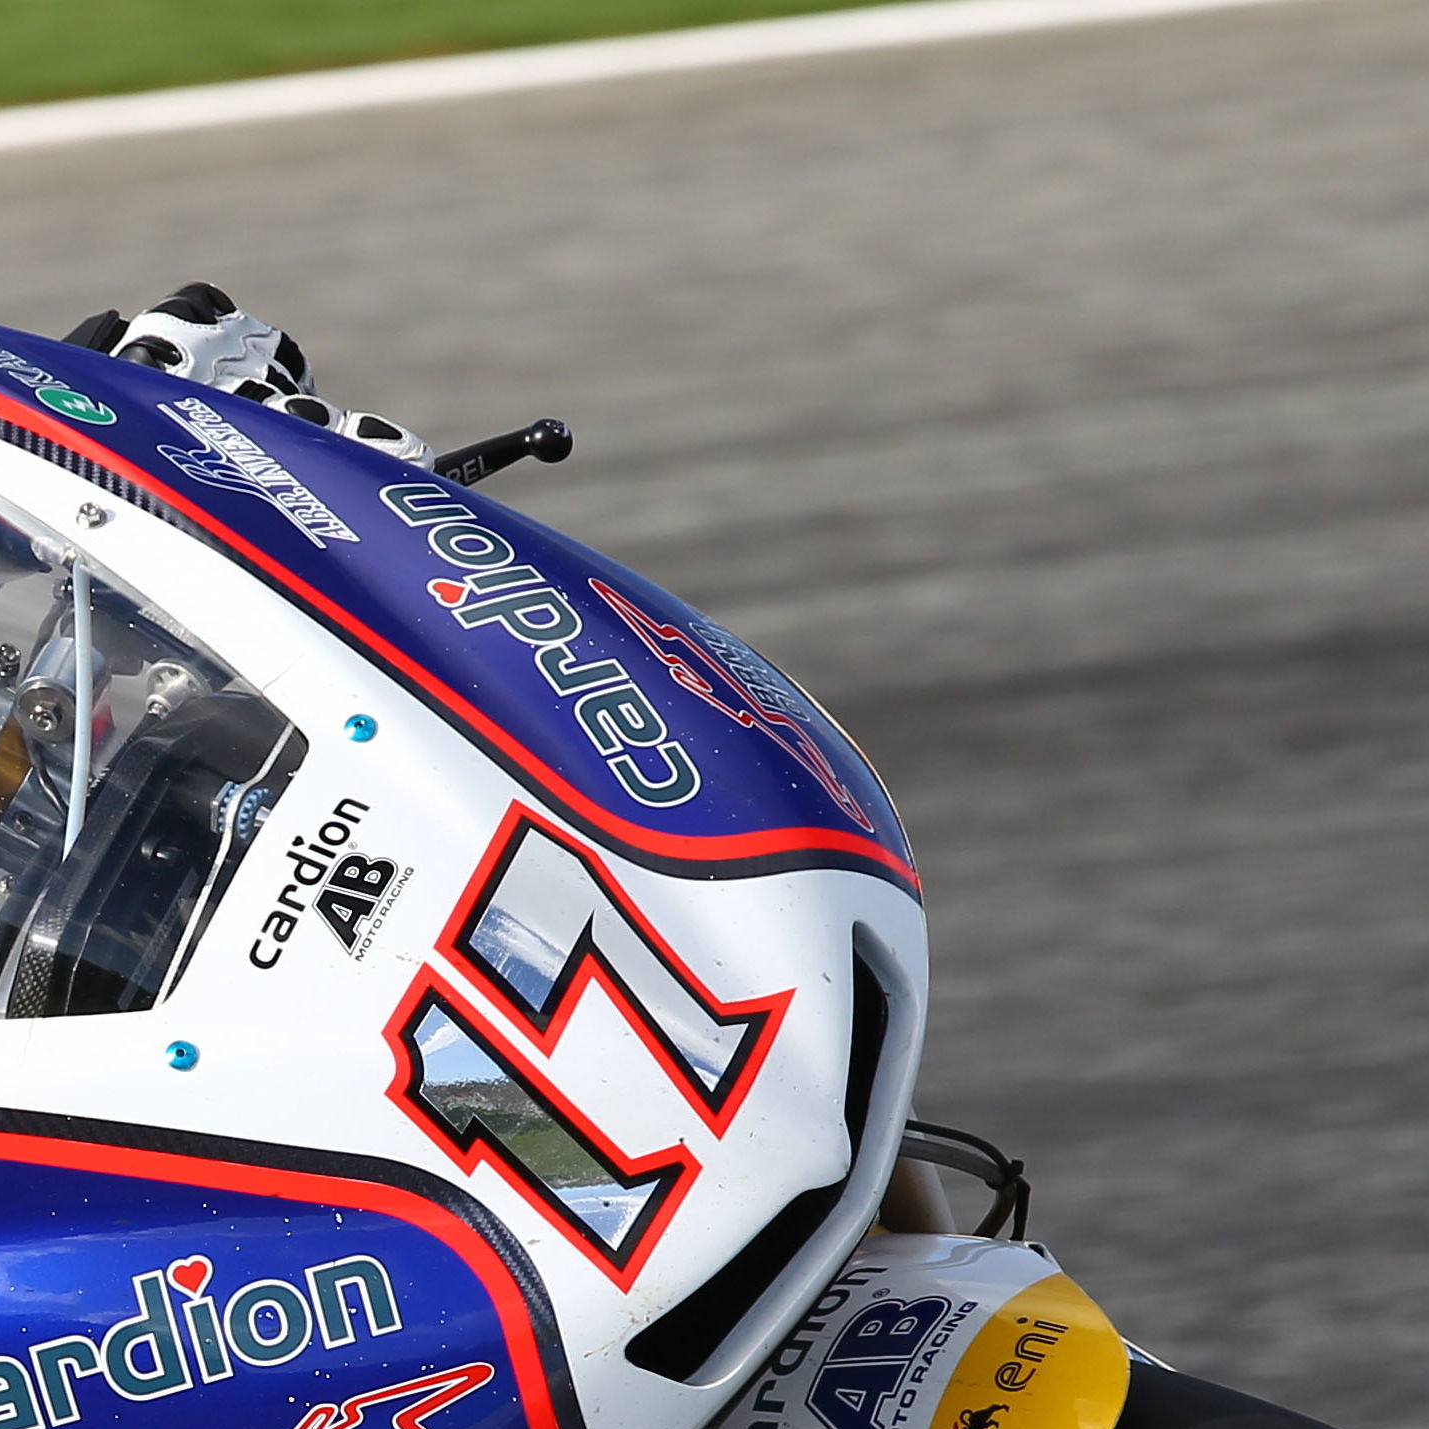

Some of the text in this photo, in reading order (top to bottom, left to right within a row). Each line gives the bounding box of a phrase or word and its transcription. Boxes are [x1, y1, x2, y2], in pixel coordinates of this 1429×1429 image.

[379, 483, 702, 809] cardion
[249, 797, 370, 970] cardion
[312, 852, 399, 956] AB
[354, 866, 415, 962] MOTO RACING
[381, 798, 797, 1295] 17
[908, 1300, 980, 1385] RACING
[995, 1316, 1071, 1393] eni
